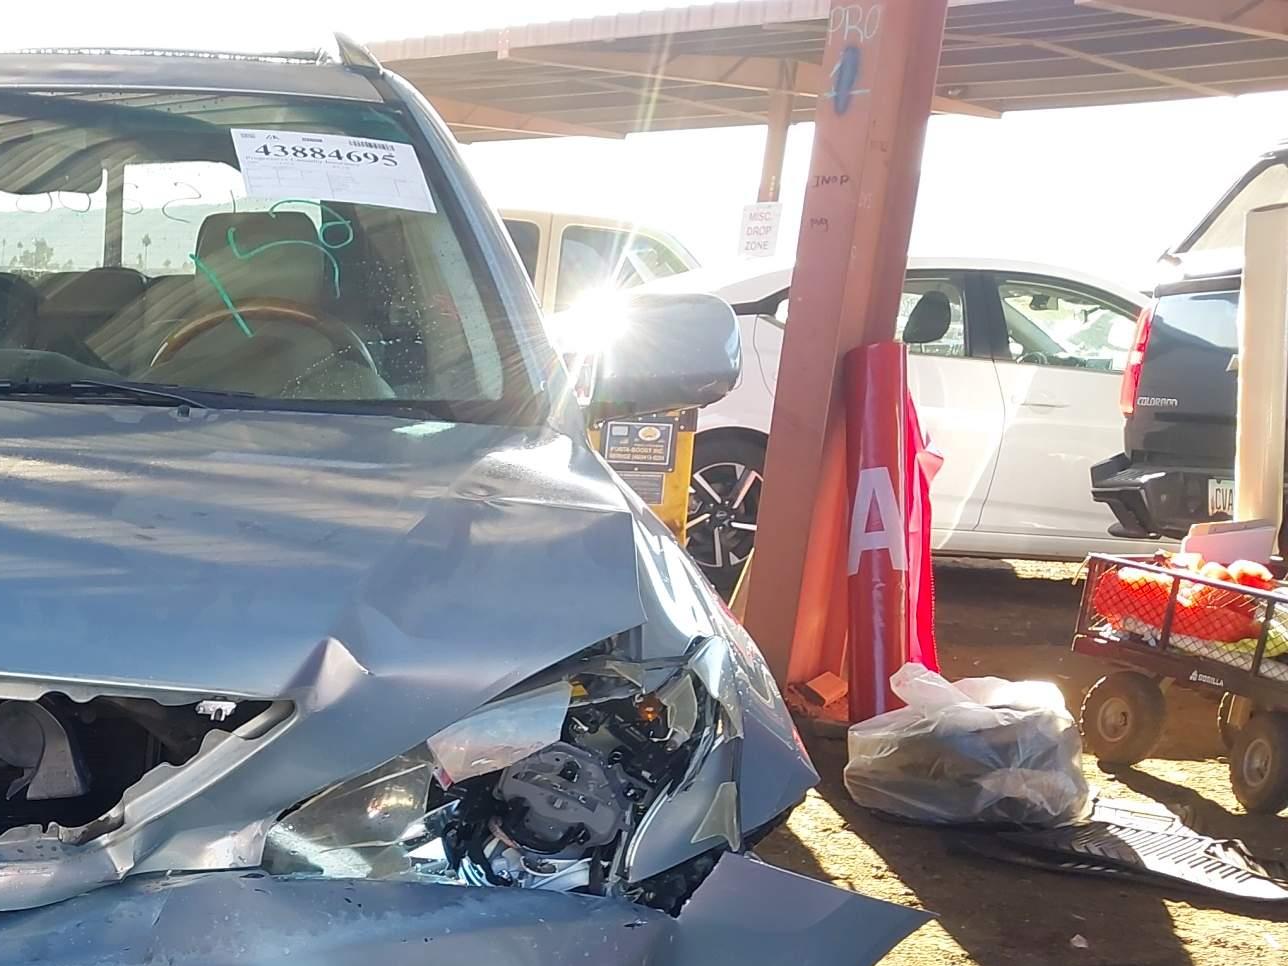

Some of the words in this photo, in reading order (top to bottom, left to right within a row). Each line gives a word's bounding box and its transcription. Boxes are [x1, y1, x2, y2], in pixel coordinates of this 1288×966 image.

[255, 143, 398, 167] 43884695
[746, 225, 772, 237] DROP
[744, 240, 769, 251] ZONE
[847, 466, 909, 577] A
